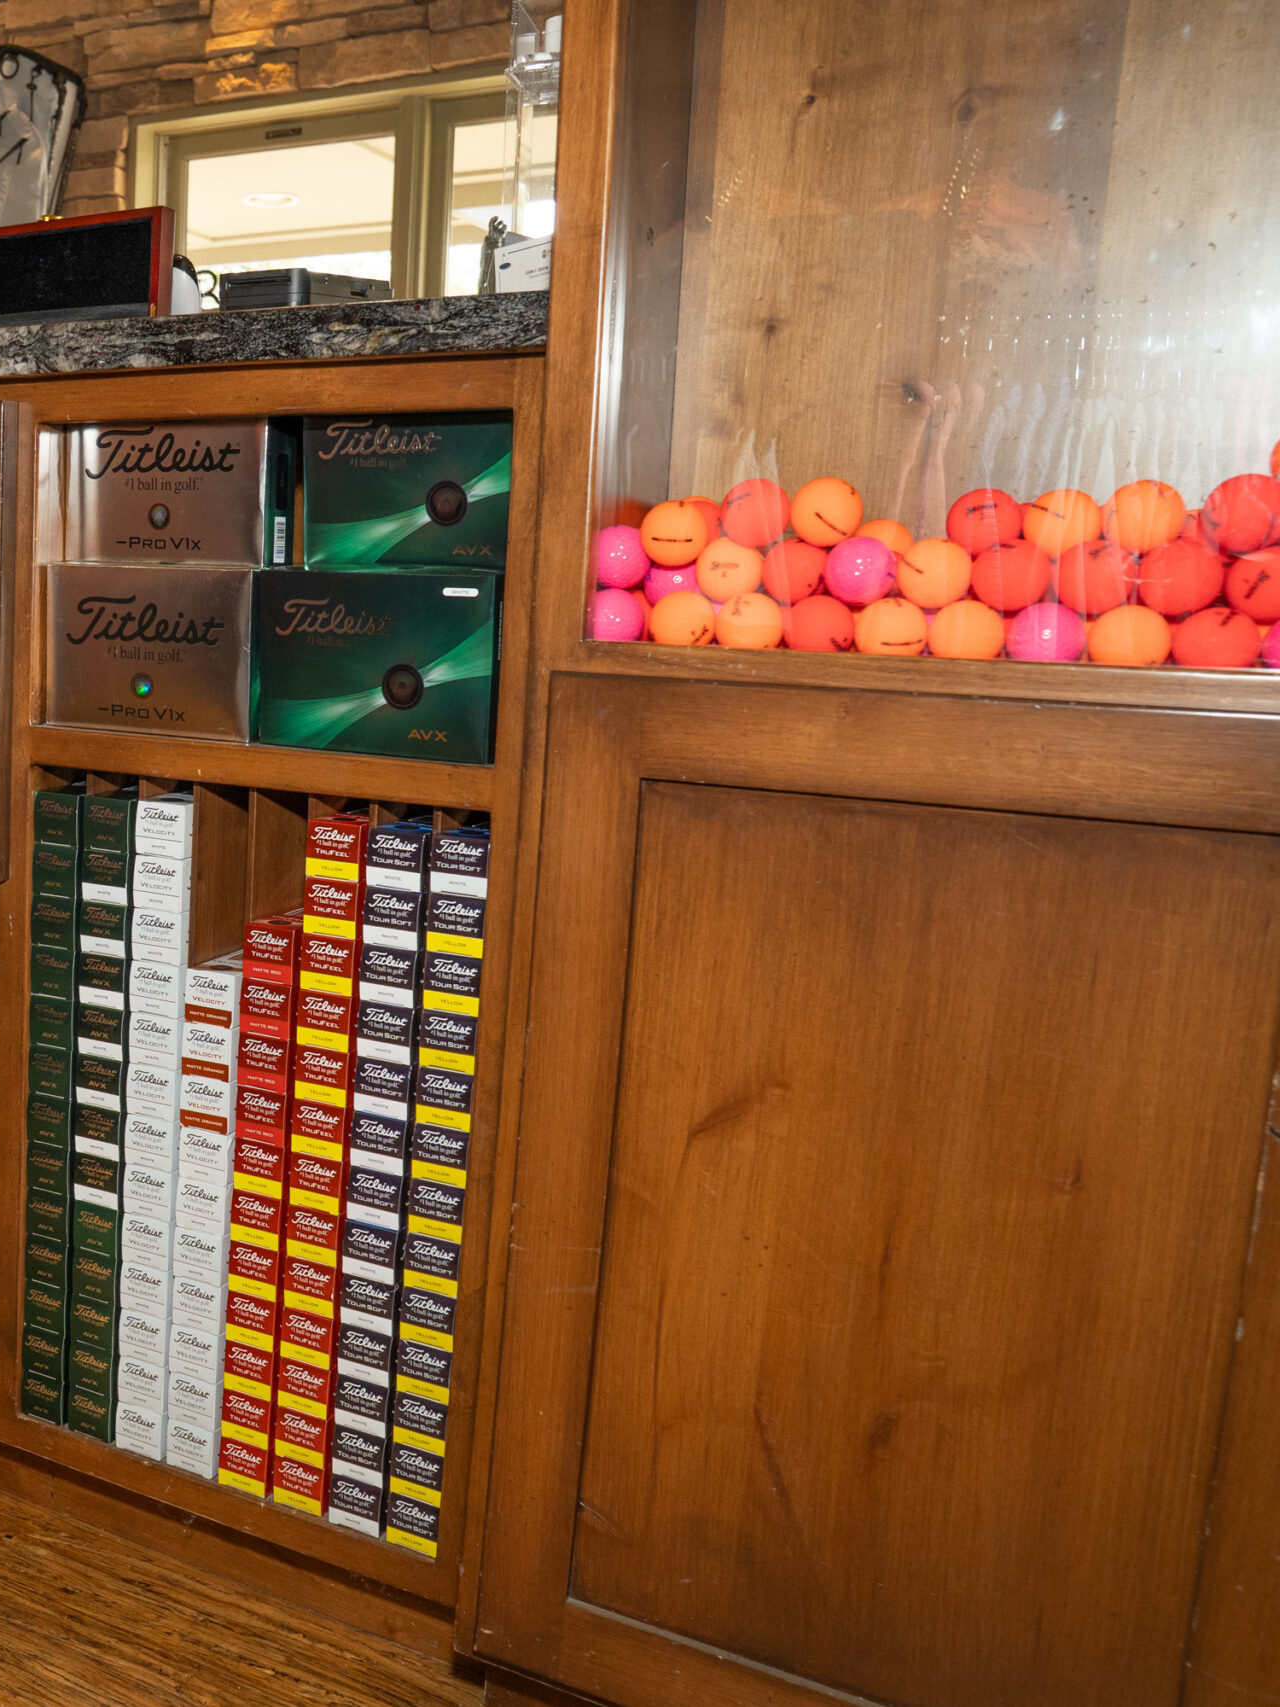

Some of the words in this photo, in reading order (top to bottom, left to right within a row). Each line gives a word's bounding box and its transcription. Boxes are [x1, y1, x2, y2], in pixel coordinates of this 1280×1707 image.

[319, 420, 442, 460] Titleist
[85, 426, 240, 480] Titleist
[135, 478, 158, 491] ball
[161, 479, 171, 491] in
[452, 545, 492, 556] AVX
[66, 595, 224, 645] Titleist
[275, 598, 397, 635] Titleist
[119, 647, 141, 659] ball
[144, 648, 154, 660] in
[408, 728, 447, 742] AVX
[141, 807, 179, 822] Titleist
[143, 827, 175, 836] VELOCITY
[311, 826, 355, 843] Titleist
[372, 835, 418, 852] Titleist
[436, 839, 484, 857] Titleist
[315, 847, 349, 858] TRUFEEL
[138, 862, 176, 877] Titleist
[372, 856, 393, 865] TOUR
[394, 859, 416, 868] SOFT
[436, 861, 458, 870] TOUR
[459, 864, 482, 873] SOFT
[141, 882, 172, 891] VELOCITY
[308, 884, 352, 901] Titleist
[369, 894, 415, 911] Titleist
[433, 900, 481, 918] Titleist
[86, 907, 119, 922] Titleist
[313, 905, 346, 916] TRUFEEL
[369, 915, 390, 924] TOUR
[391, 918, 412, 927] SOFT
[433, 922, 455, 931] TOUR
[456, 925, 479, 934] SOFT
[92, 928, 110, 936] AVX
[247, 930, 288, 946] Titleist
[251, 951, 283, 961] TRUFEEL
[190, 976, 229, 991] Titleist
[192, 996, 225, 1006] VELOCITY
[244, 985, 286, 1002] Titleist
[248, 1006, 280, 1016] TRUFEEL
[187, 1029, 226, 1045] Titleist
[189, 1049, 224, 1059] VELOCITY
[235, 1196, 275, 1215] Titleist
[238, 1215, 270, 1229] TRUFEEL
[347, 1229, 392, 1248] Titleist
[120, 1409, 155, 1429] Titleist
[170, 1426, 207, 1447] Titleist
[223, 1443, 262, 1464] Titleist
[227, 1462, 256, 1476] TRUFEEL
[278, 1461, 319, 1483] Titleist
[282, 1480, 312, 1495] TRUFEEL
[333, 1481, 376, 1503] Titleist
[333, 1499, 352, 1510] TOUR
[353, 1505, 373, 1516] SOFT
[391, 1500, 436, 1523] Titleist
[392, 1518, 412, 1530] TOUR
[413, 1524, 434, 1537] SOFT
